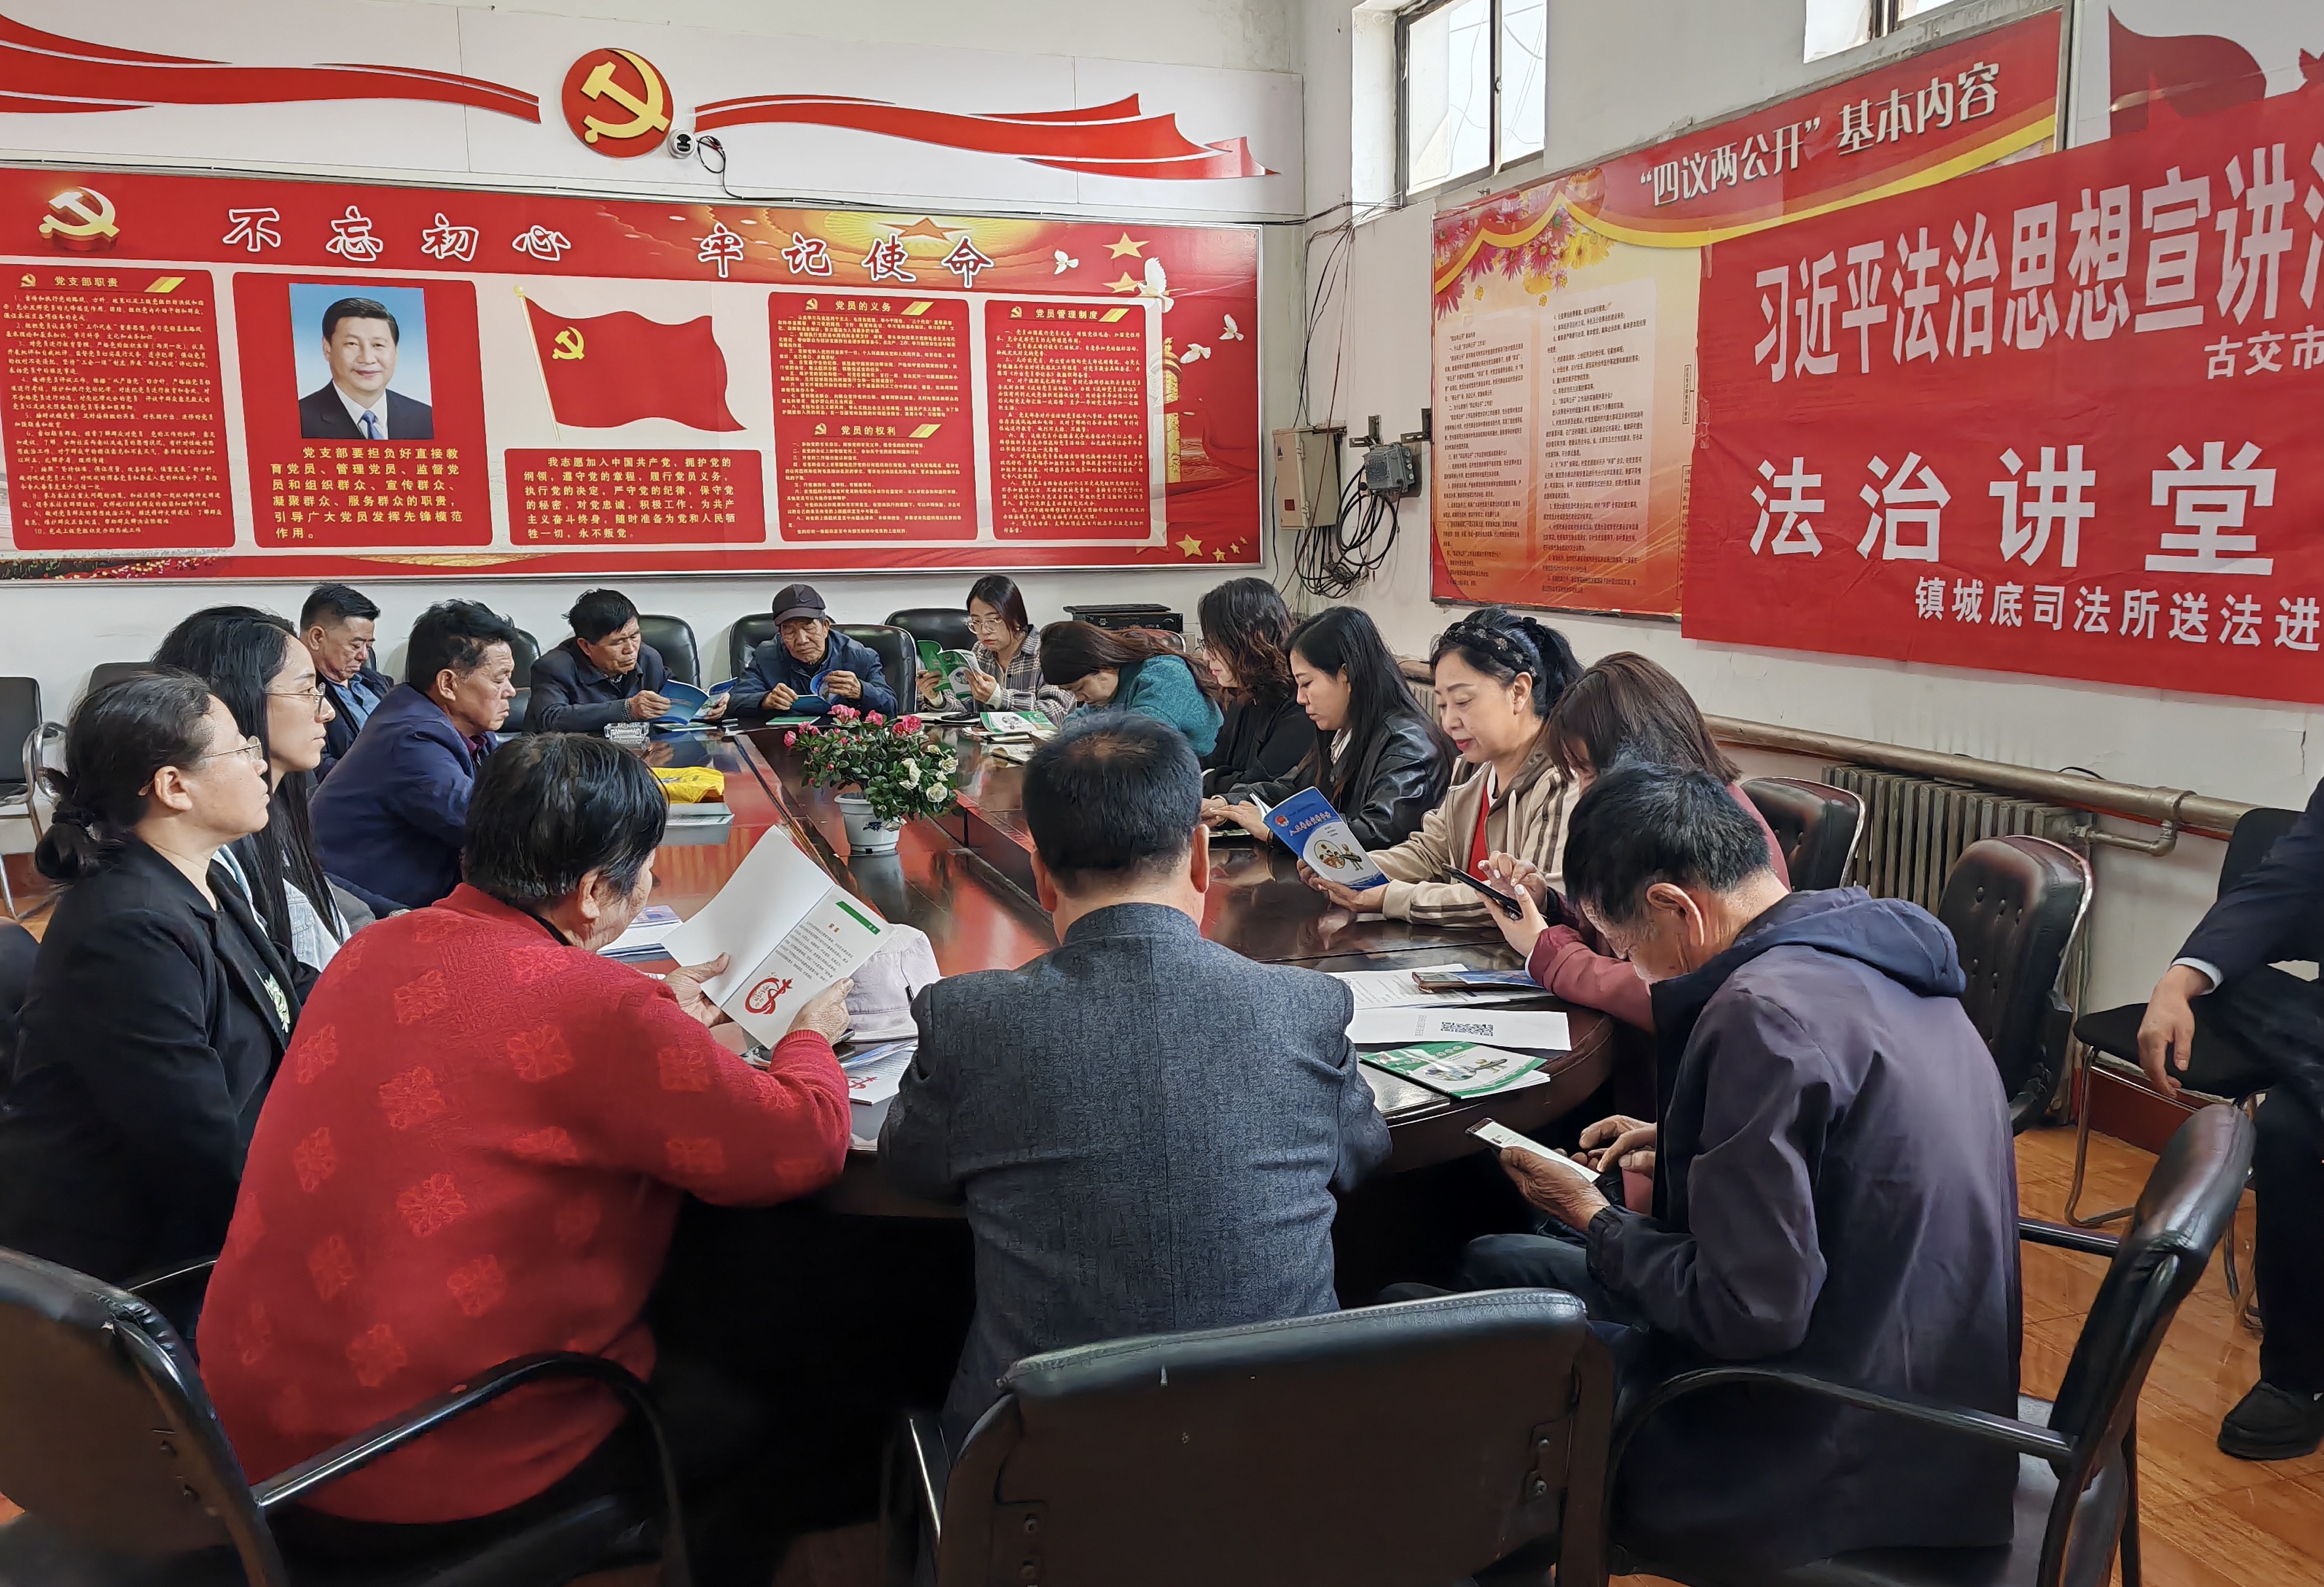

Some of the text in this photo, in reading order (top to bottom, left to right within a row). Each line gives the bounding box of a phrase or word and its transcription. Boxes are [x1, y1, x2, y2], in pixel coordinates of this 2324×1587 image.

[1639, 62, 2000, 207] “四议两公开”基本内容
[222, 205, 572, 262] 不忘初心
[697, 222, 995, 289] 牢记使命
[54, 276, 118, 287] 党支部职责
[835, 300, 891, 312] 党员的义务
[1036, 308, 1102, 322] 党员管理制度
[2203, 324, 2324, 381] 古交市
[841, 425, 896, 436] 党员的权利
[303, 446, 458, 459] 党支部要担负好直接教
[547, 456, 731, 468] 我志愿加入中国共产党，拥护党的
[523, 471, 728, 482] 纲领，遵守党的章程，履行党员义务，
[272, 478, 454, 491] 员和组织群众、宣传群众、
[524, 484, 734, 496] 执行党的决定，严守党的纪律，保守党
[272, 495, 454, 507] 凝聚群众、服务群众的职责，
[526, 498, 734, 511] 的秘密，对党忠诚，积极工作，为共产
[1750, 441, 2277, 576] 法治讲堂
[274, 510, 463, 523] 引导广大党员发挥先锋模范
[527, 513, 736, 525] 主义奋斗终身，随时准备为党和人民牺
[276, 527, 314, 539] 作用。
[528, 528, 633, 539] 牲一切，永不叛党。
[1914, 575, 2321, 652] 镇城底司法所送法进
